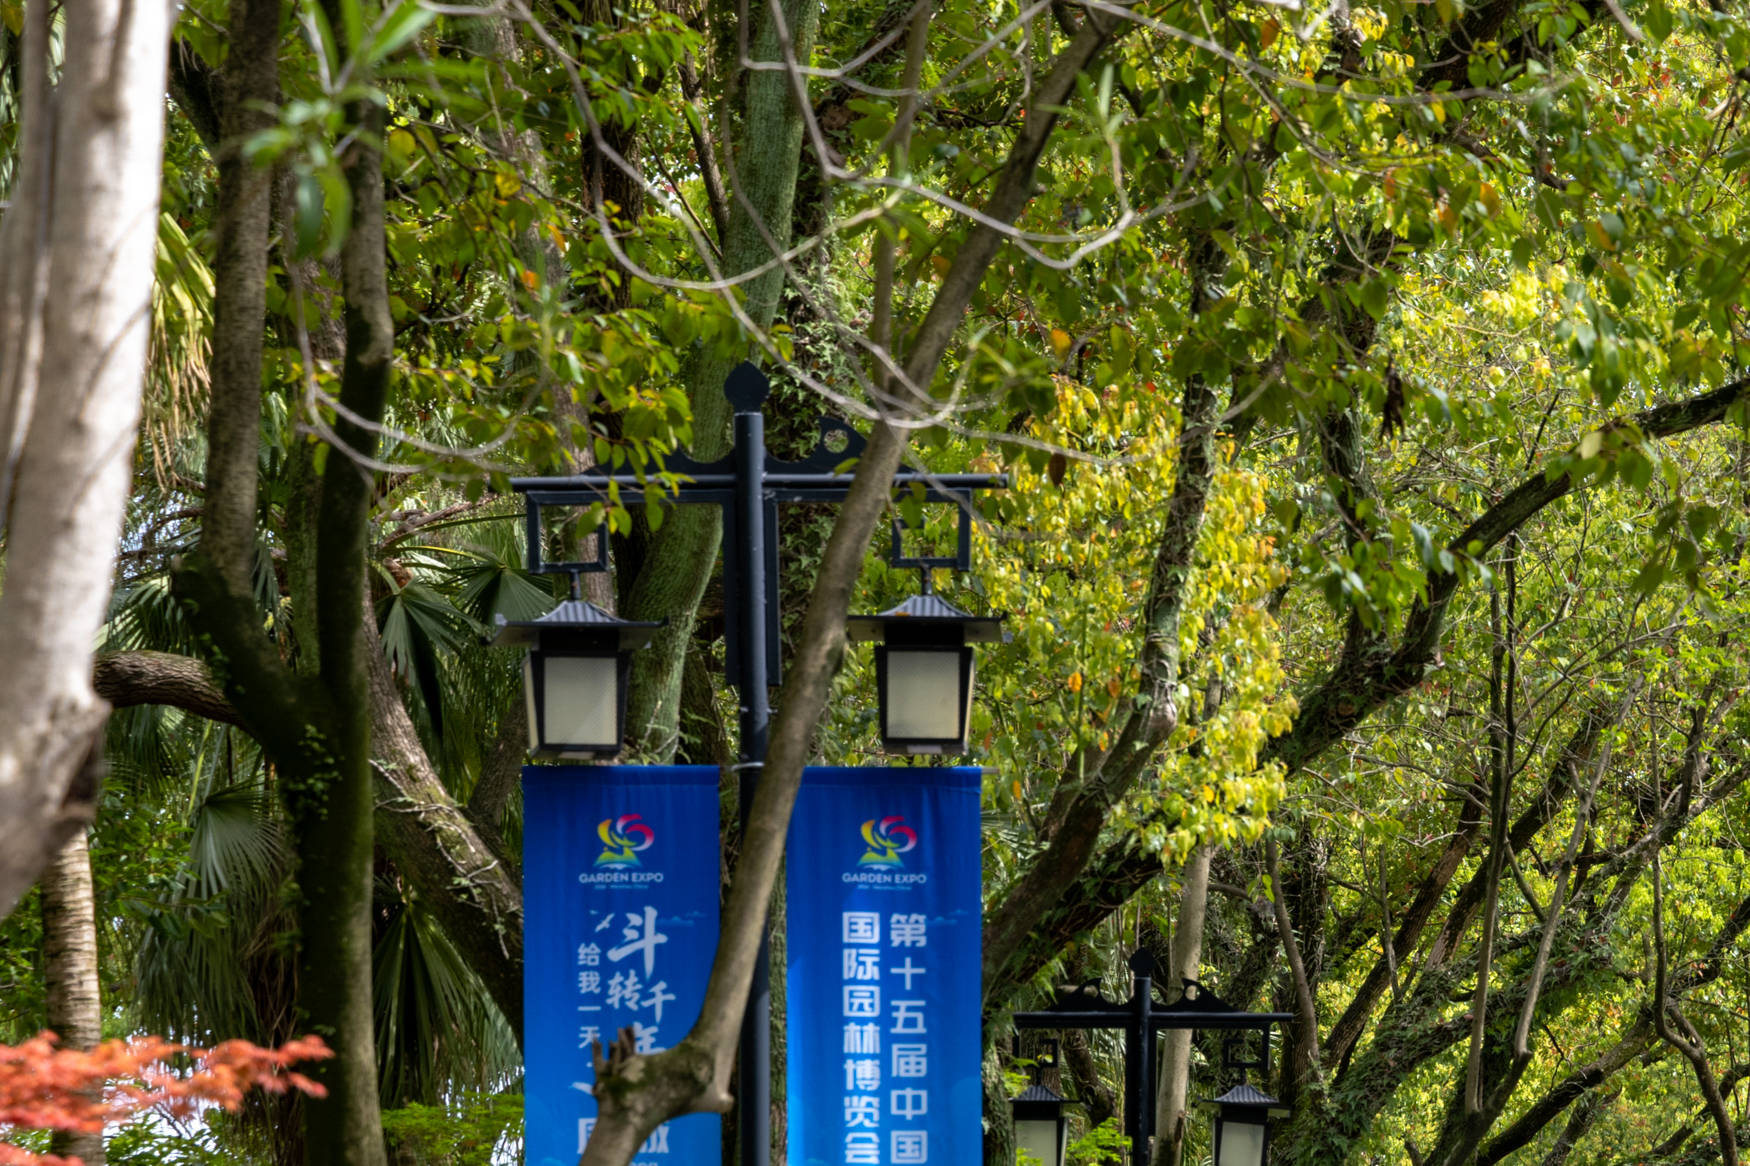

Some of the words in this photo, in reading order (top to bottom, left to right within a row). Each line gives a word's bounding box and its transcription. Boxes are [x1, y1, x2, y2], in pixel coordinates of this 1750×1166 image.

[578, 872, 629, 884] GARDEN
[631, 872, 664, 883] EXPO
[842, 872, 892, 884] GARDEN
[894, 873, 927, 885] EXPO
[842, 911, 881, 1165] 国际园林博览会
[890, 912, 929, 1165] 第十五届中国
